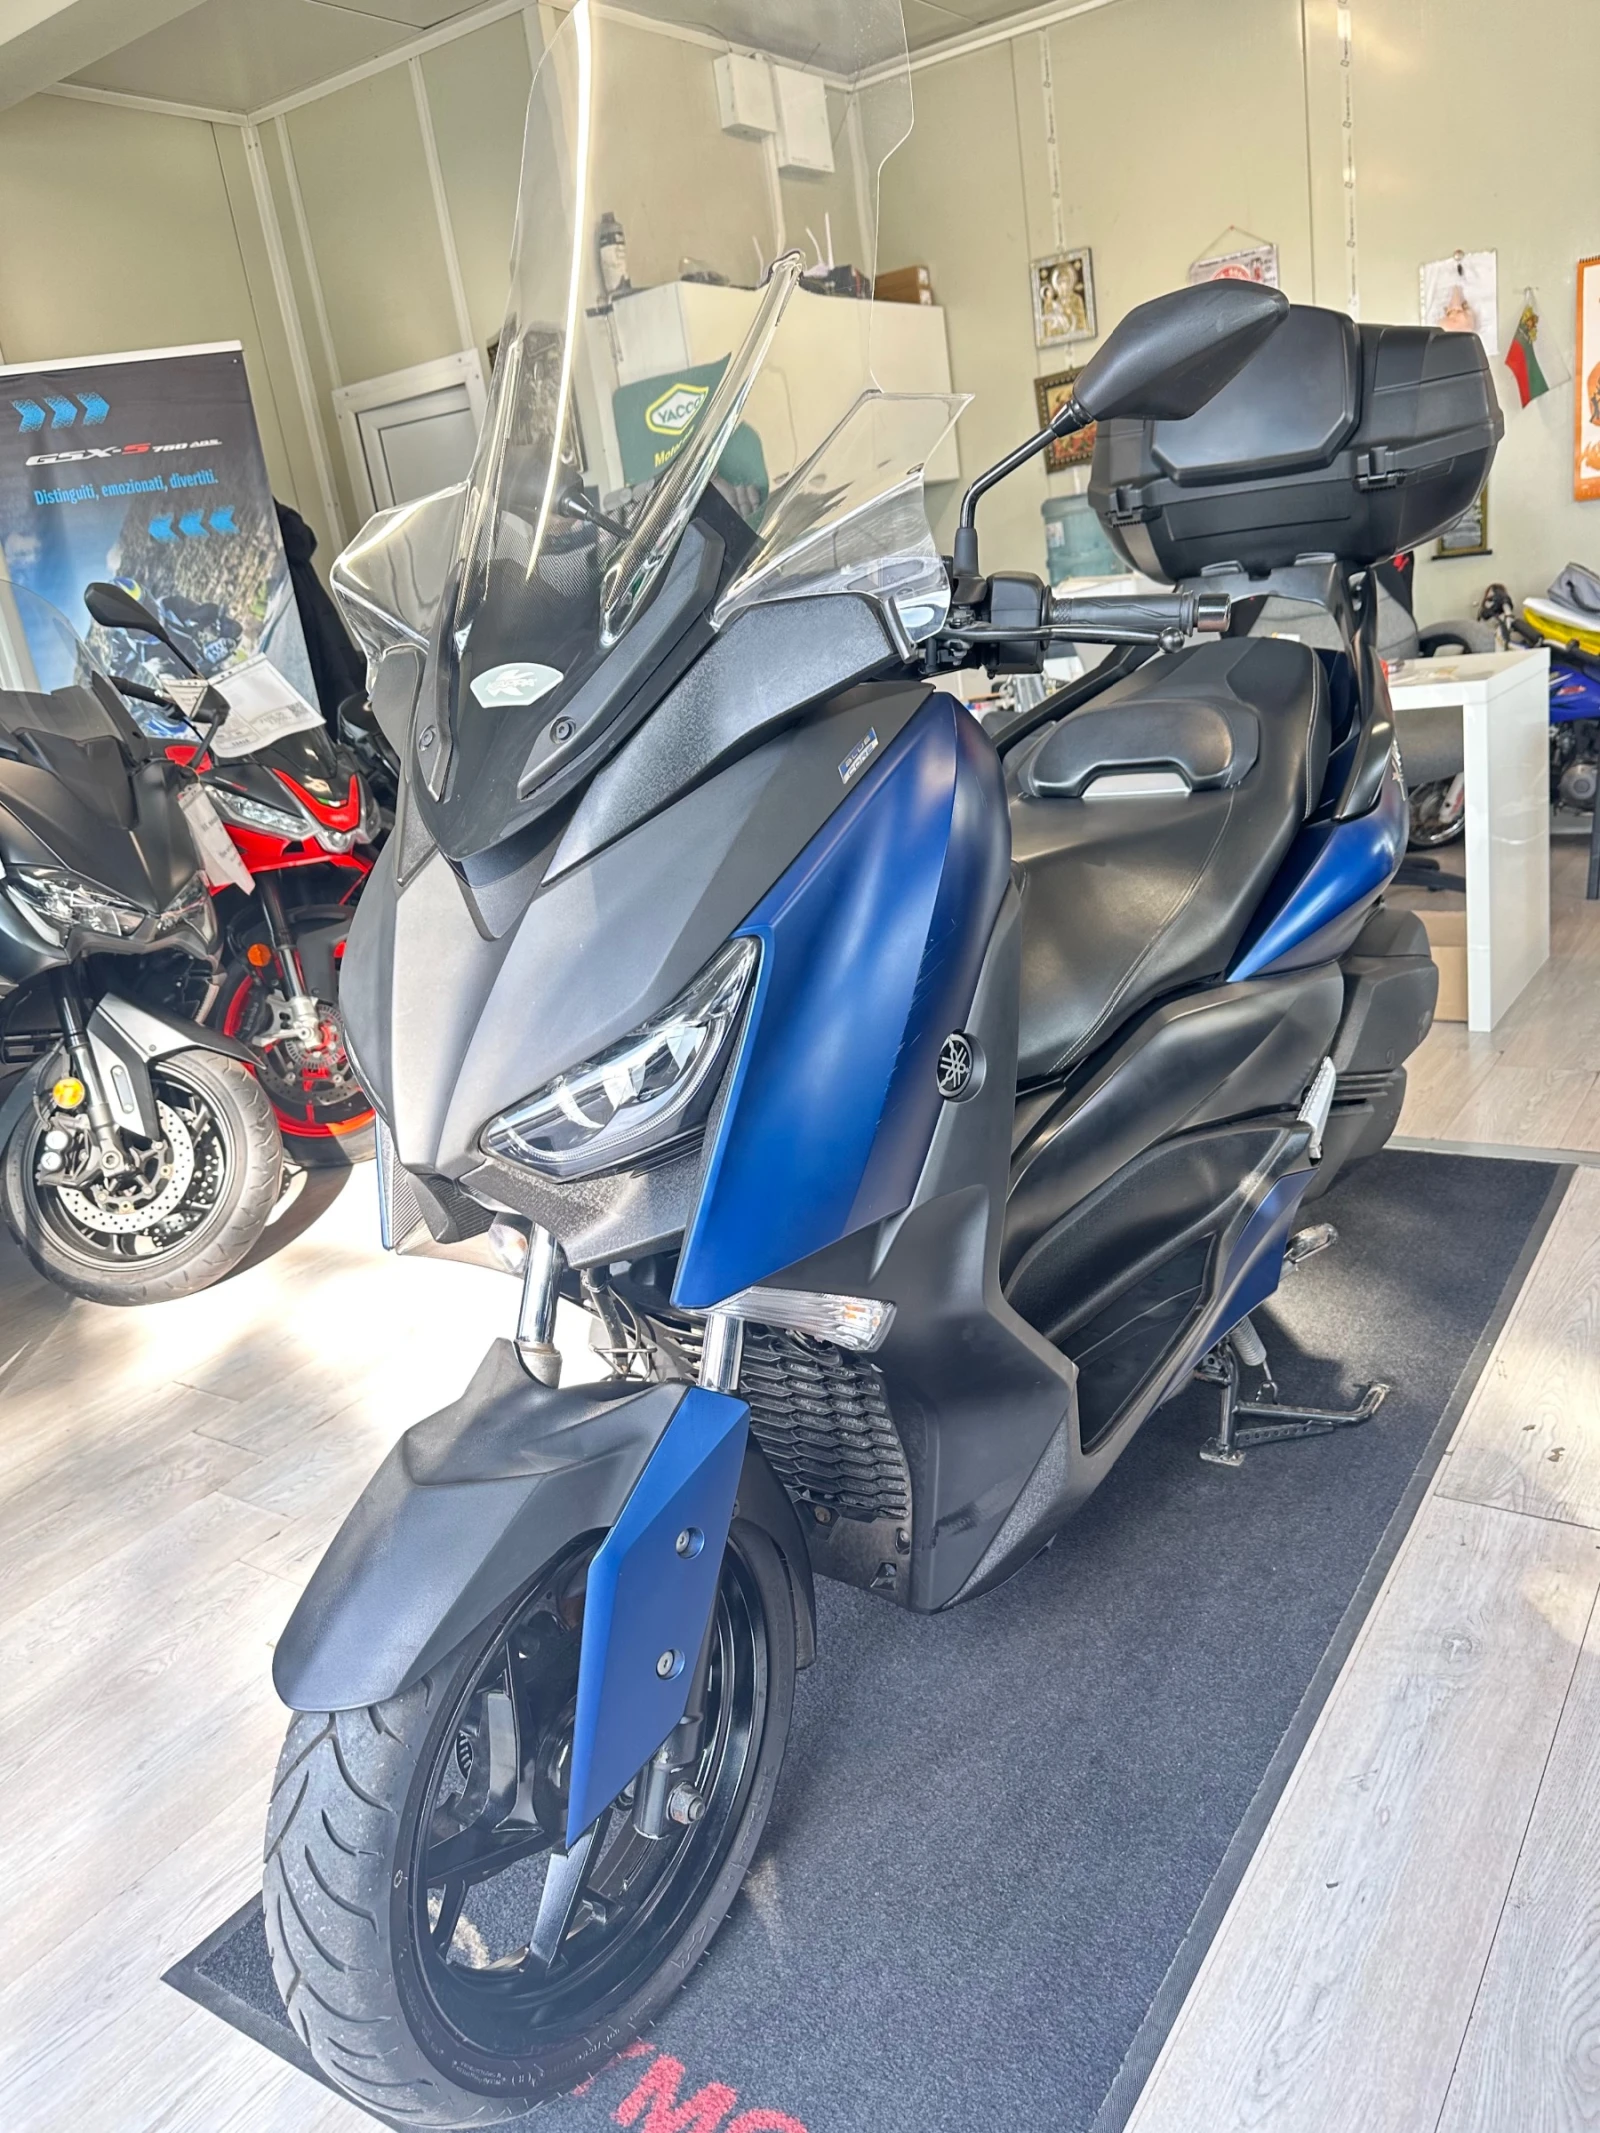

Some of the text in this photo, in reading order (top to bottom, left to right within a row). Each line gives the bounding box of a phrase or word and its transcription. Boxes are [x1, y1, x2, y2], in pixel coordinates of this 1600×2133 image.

[33, 468, 219, 505] Distinguiti, emozionati, divertiti.
